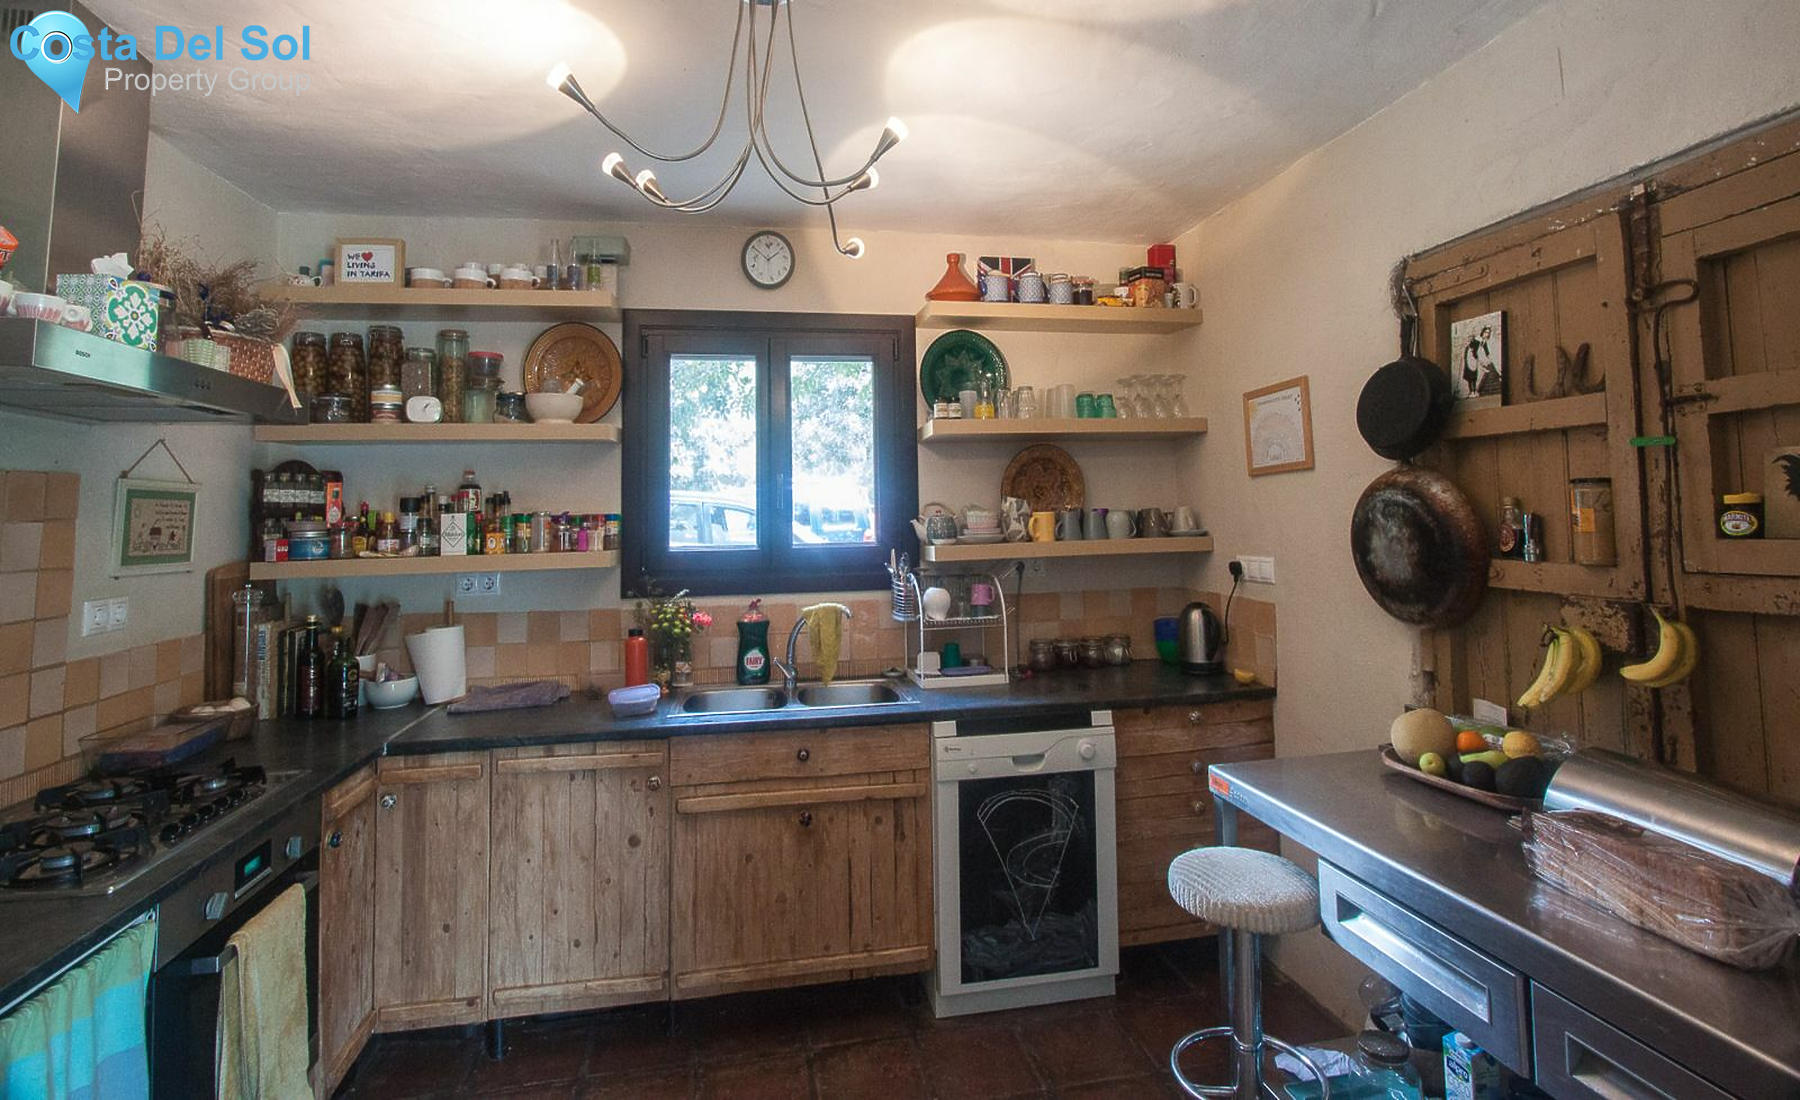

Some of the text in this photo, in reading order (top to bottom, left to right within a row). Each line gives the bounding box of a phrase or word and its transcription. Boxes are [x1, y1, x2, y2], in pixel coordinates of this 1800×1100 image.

[347, 252, 361, 260] WE
[347, 270, 357, 278] IN
[746, 655, 764, 666] FAIRY
